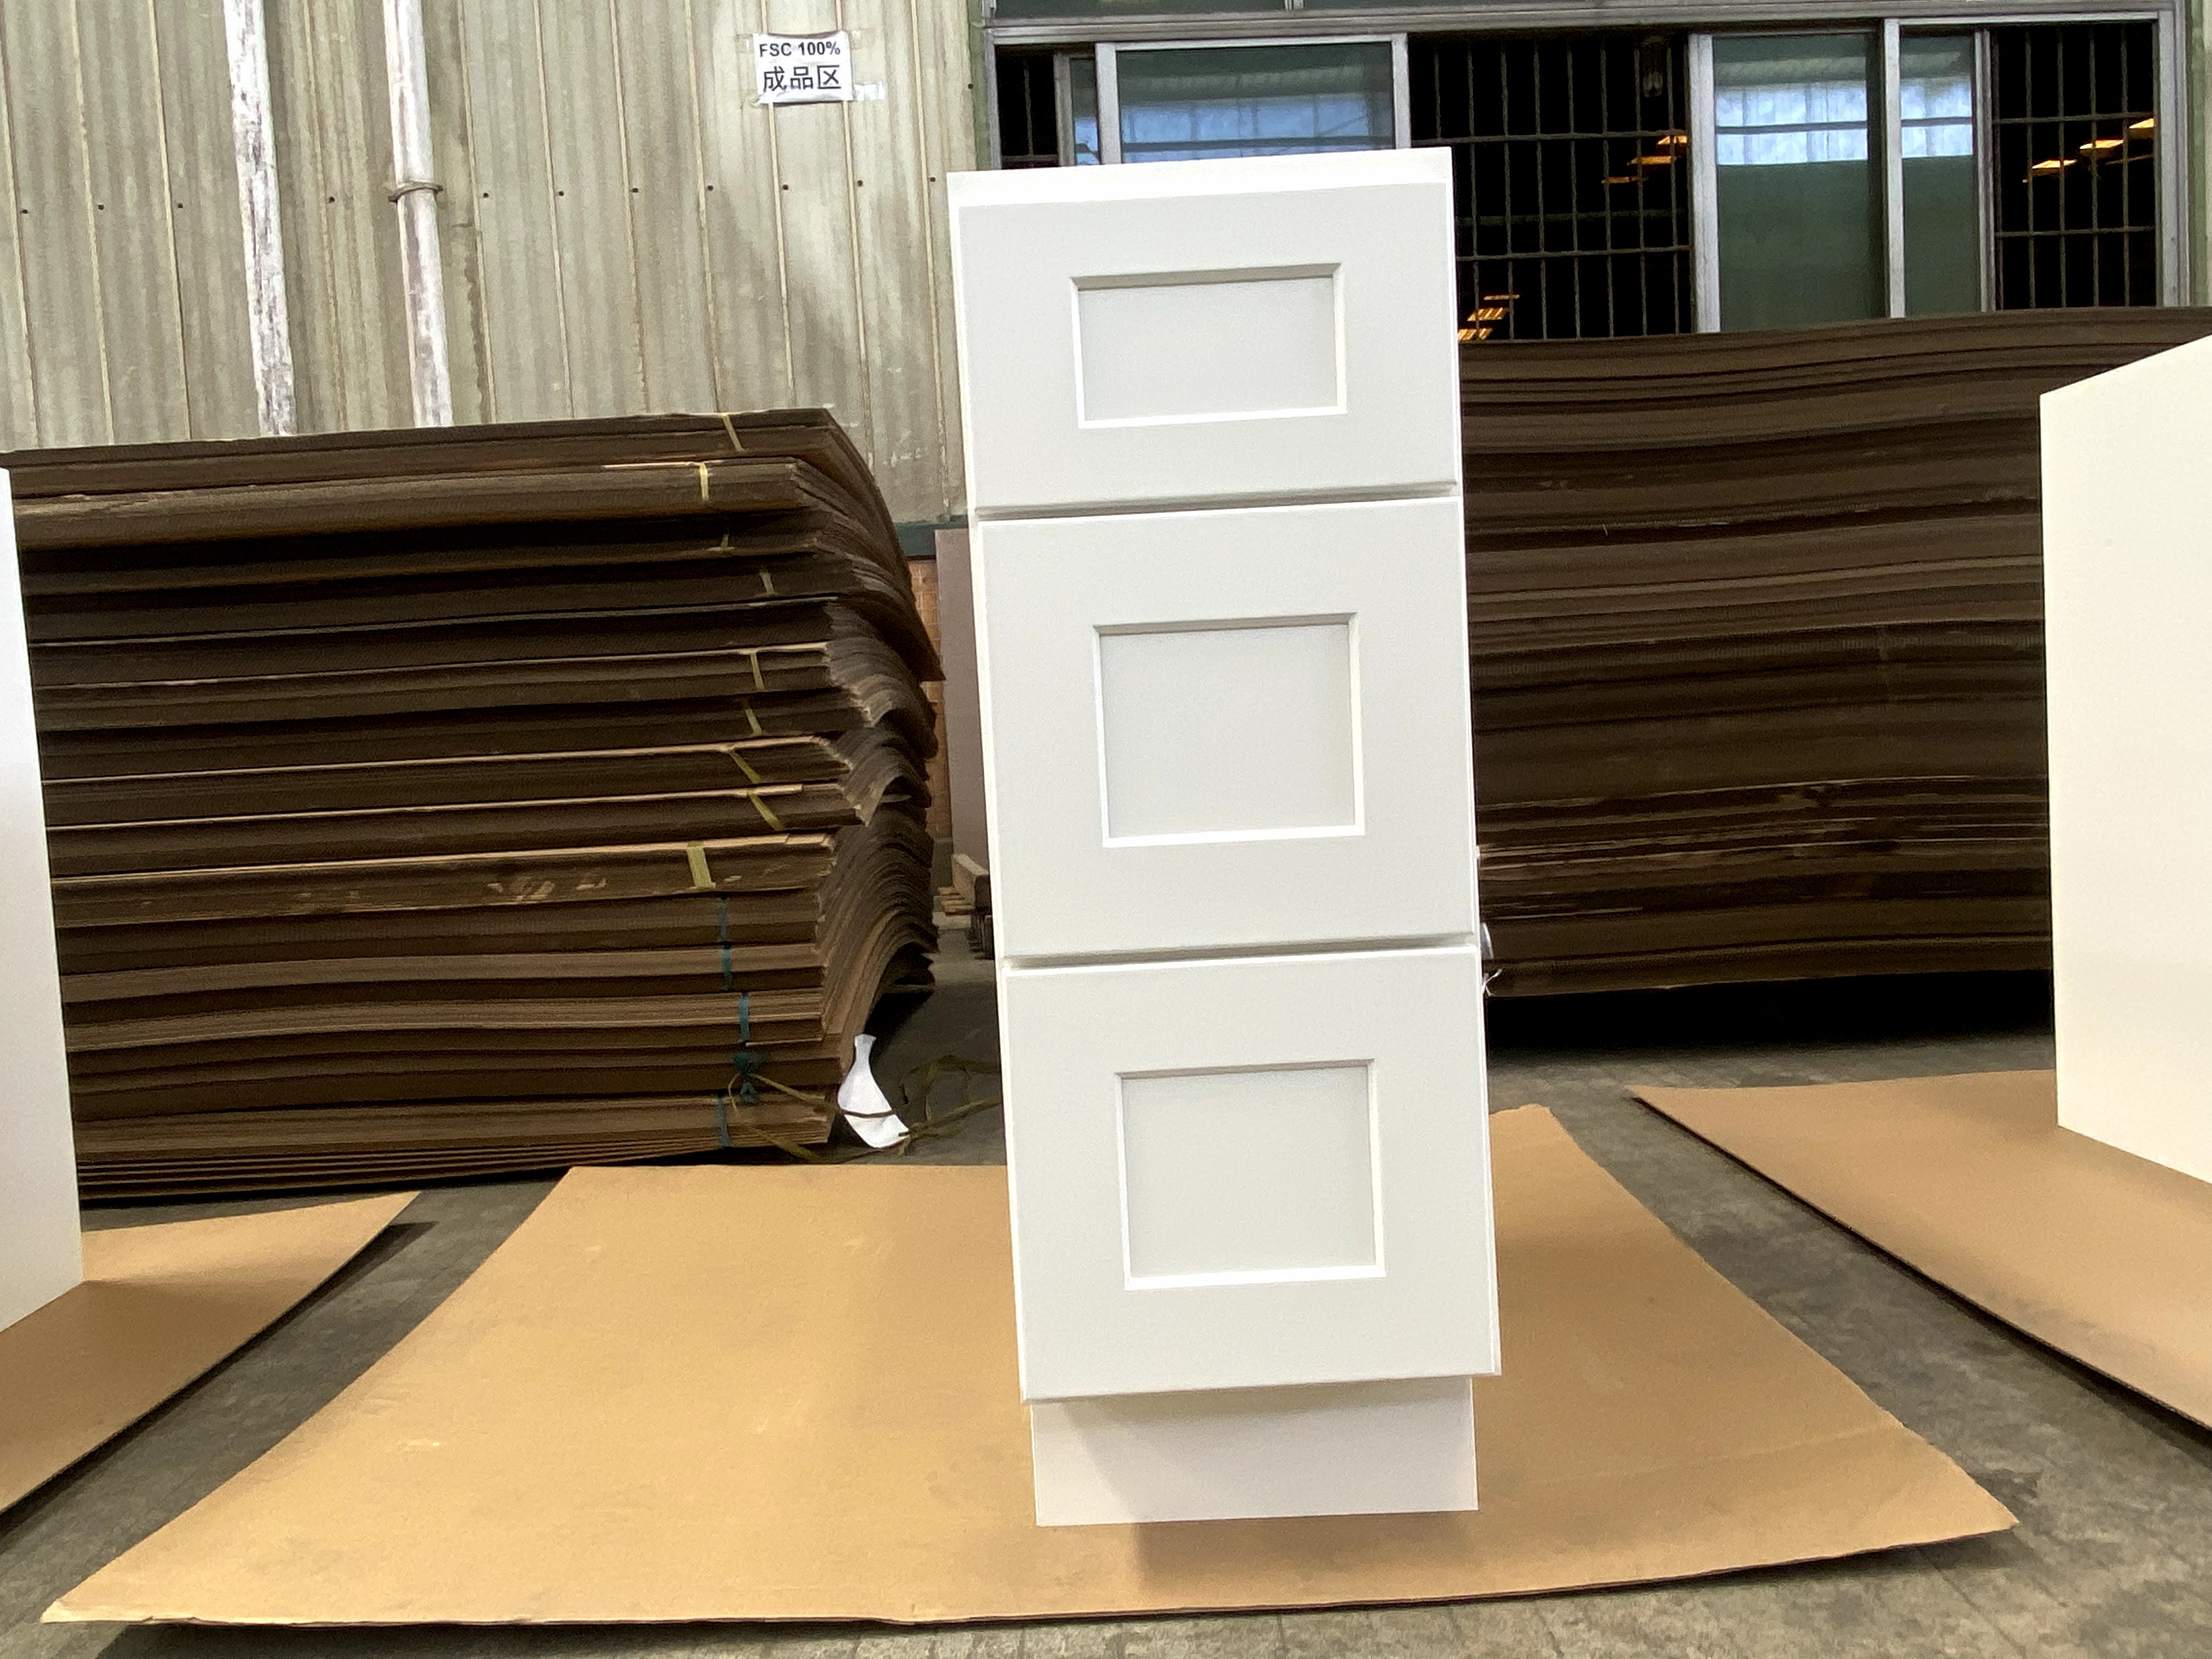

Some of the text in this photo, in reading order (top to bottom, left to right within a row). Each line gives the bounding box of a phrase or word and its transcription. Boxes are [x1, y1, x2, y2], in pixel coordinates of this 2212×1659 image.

[759, 41, 840, 57] FSC 100%
[763, 65, 841, 92] 成品区
